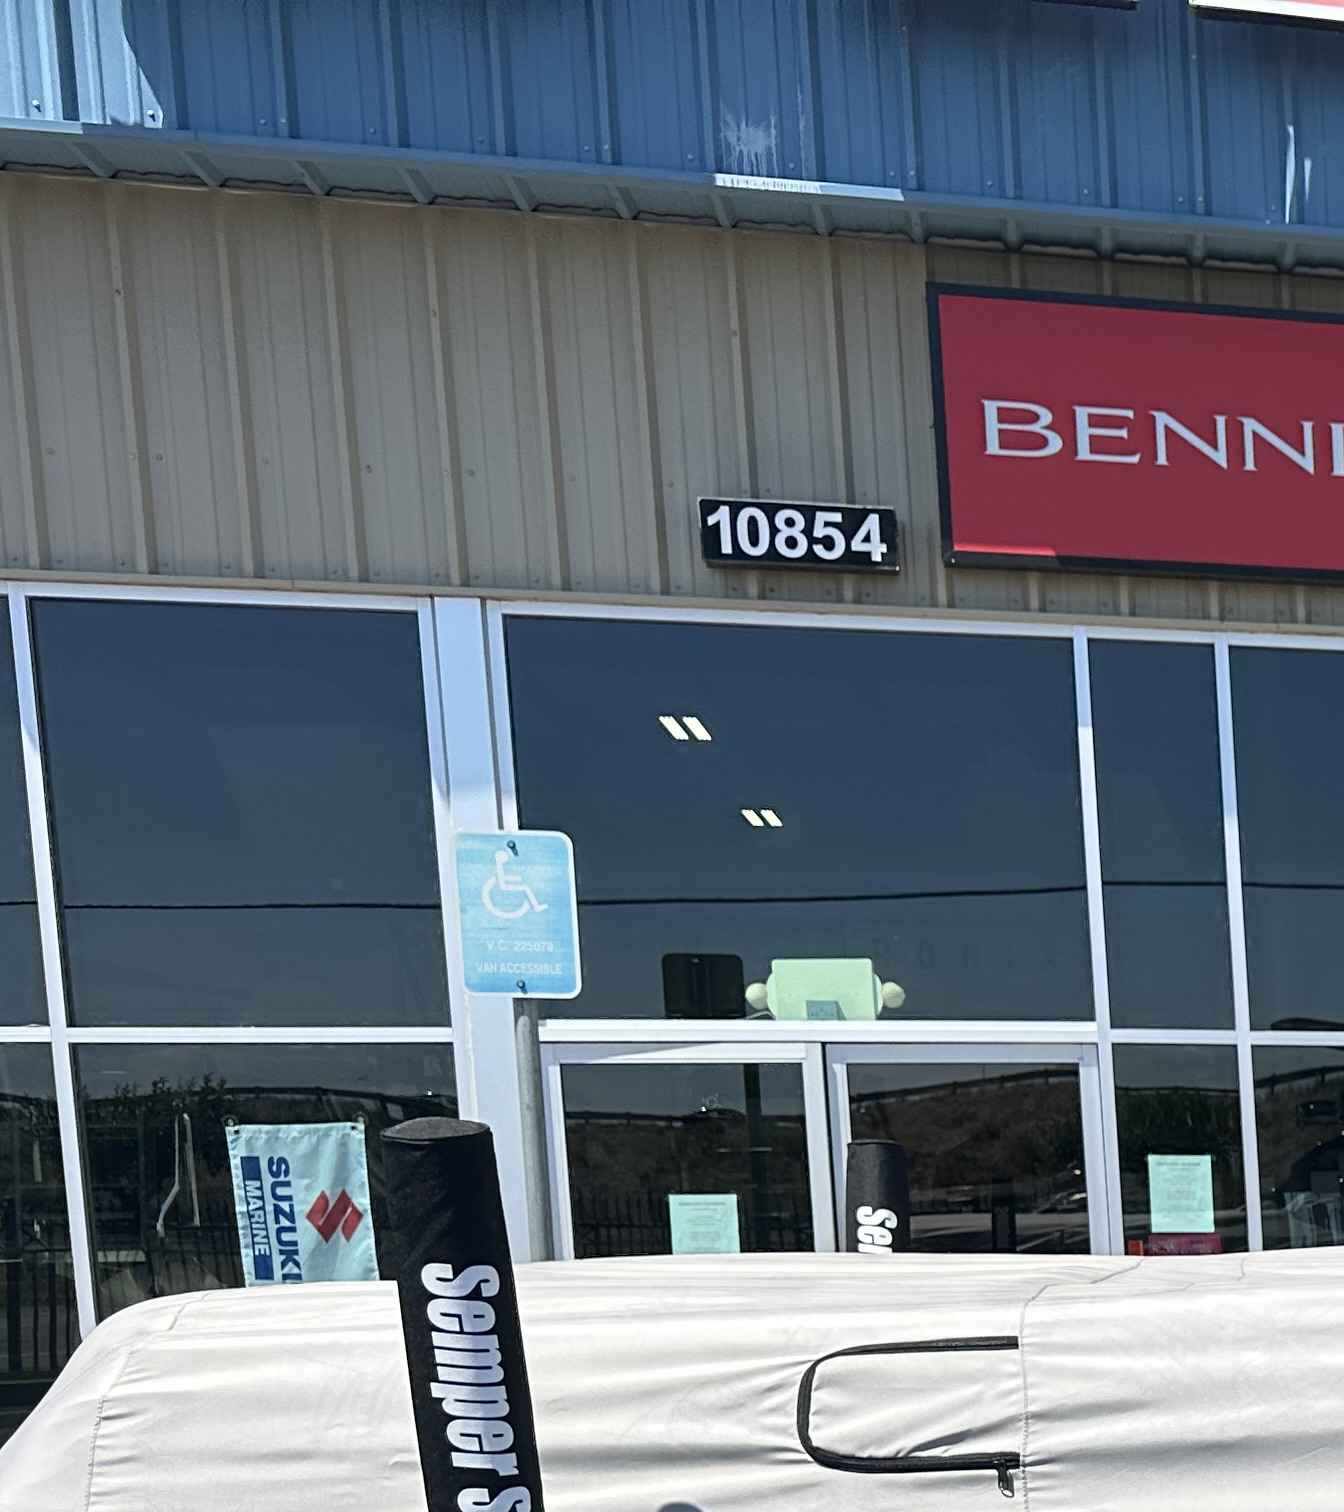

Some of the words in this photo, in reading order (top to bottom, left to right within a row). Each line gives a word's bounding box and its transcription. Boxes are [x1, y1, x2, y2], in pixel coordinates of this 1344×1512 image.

[704, 504, 887, 563] 10854
[499, 961, 563, 975] ACCESSIBLE
[244, 1179, 271, 1257] MARINE
[267, 1155, 304, 1282] SUZUKI
[420, 1262, 520, 1479] Semper
